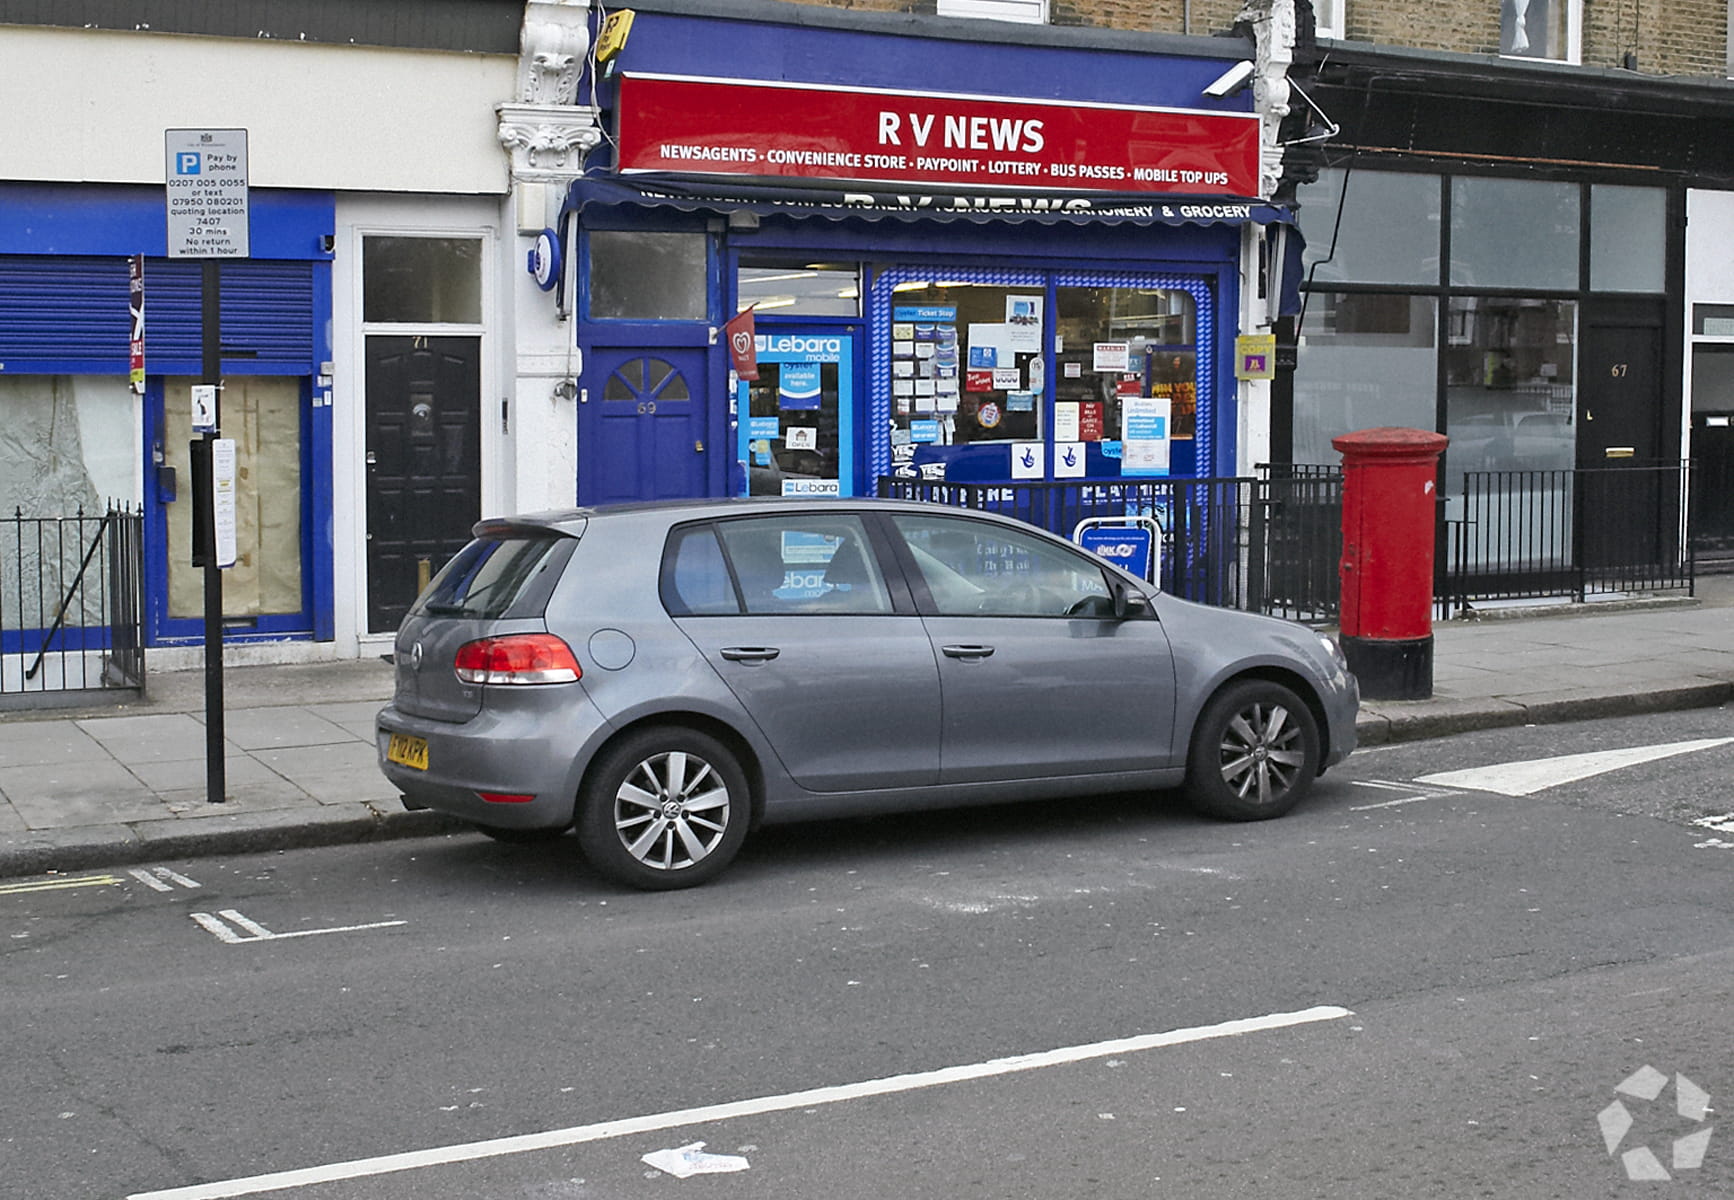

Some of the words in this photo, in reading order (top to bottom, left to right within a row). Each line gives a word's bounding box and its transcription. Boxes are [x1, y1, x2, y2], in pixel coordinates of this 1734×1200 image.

[878, 111, 901, 145] R
[909, 113, 935, 147] V
[944, 115, 1045, 153] NEWS
[207, 153, 223, 162] Pay
[226, 153, 237, 162] by
[182, 155, 197, 173] P
[208, 163, 236, 171] phone
[660, 144, 756, 162] NEWSAGENTS
[767, 149, 861, 168] CONVENIENCE
[864, 154, 907, 169] STORE
[916, 157, 979, 173] PAYPOINT
[988, 161, 1041, 176] LOTTERY
[1050, 163, 1076, 178] BUS
[1079, 165, 1125, 180] PASSES
[1133, 168, 1178, 183] MOBILE
[1180, 170, 1203, 184] TOP
[1205, 172, 1229, 185] UPS
[169, 179, 194, 187] 0207
[196, 179, 216, 187] 005
[221, 179, 245, 187] 0055
[172, 198, 203, 206] 07950
[206, 198, 243, 206] 080201
[171, 208, 205, 216] quoting
[1162, 205, 1173, 218] &
[1180, 205, 1250, 219] GROCERY
[189, 227, 202, 235] 30
[179, 247, 208, 255] within
[217, 247, 238, 255] hour
[412, 336, 428, 348] 71
[768, 335, 840, 352] Lebara
[1240, 345, 1271, 354] COPY
[806, 353, 840, 362] mobile
[1611, 364, 1628, 377] 67
[637, 401, 656, 414] 69
[795, 482, 838, 493] Lebara
